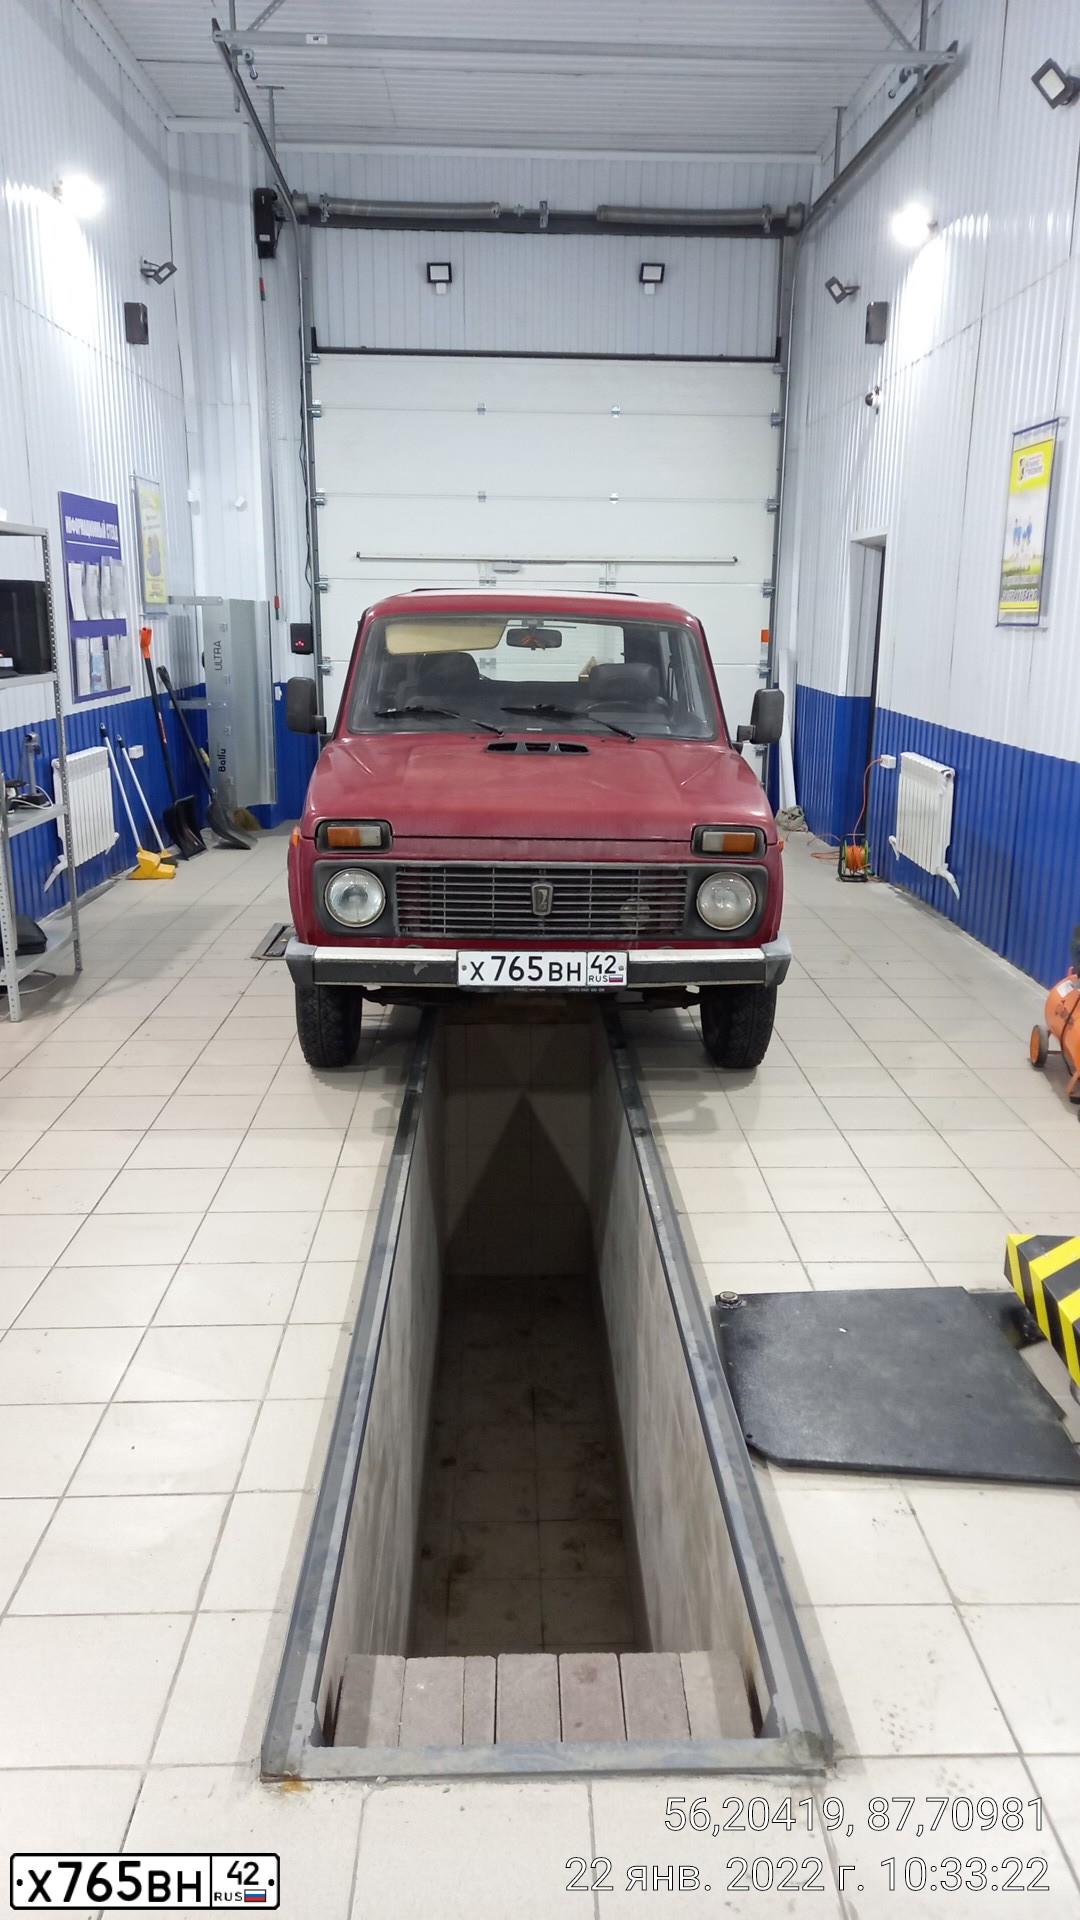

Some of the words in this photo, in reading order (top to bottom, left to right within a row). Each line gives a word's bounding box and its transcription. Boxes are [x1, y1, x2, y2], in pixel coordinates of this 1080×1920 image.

[213, 640, 223, 671] ULTRA
[218, 748, 227, 773] Ballu
[590, 955, 617, 974] 42
[588, 975, 609, 983] RUS
